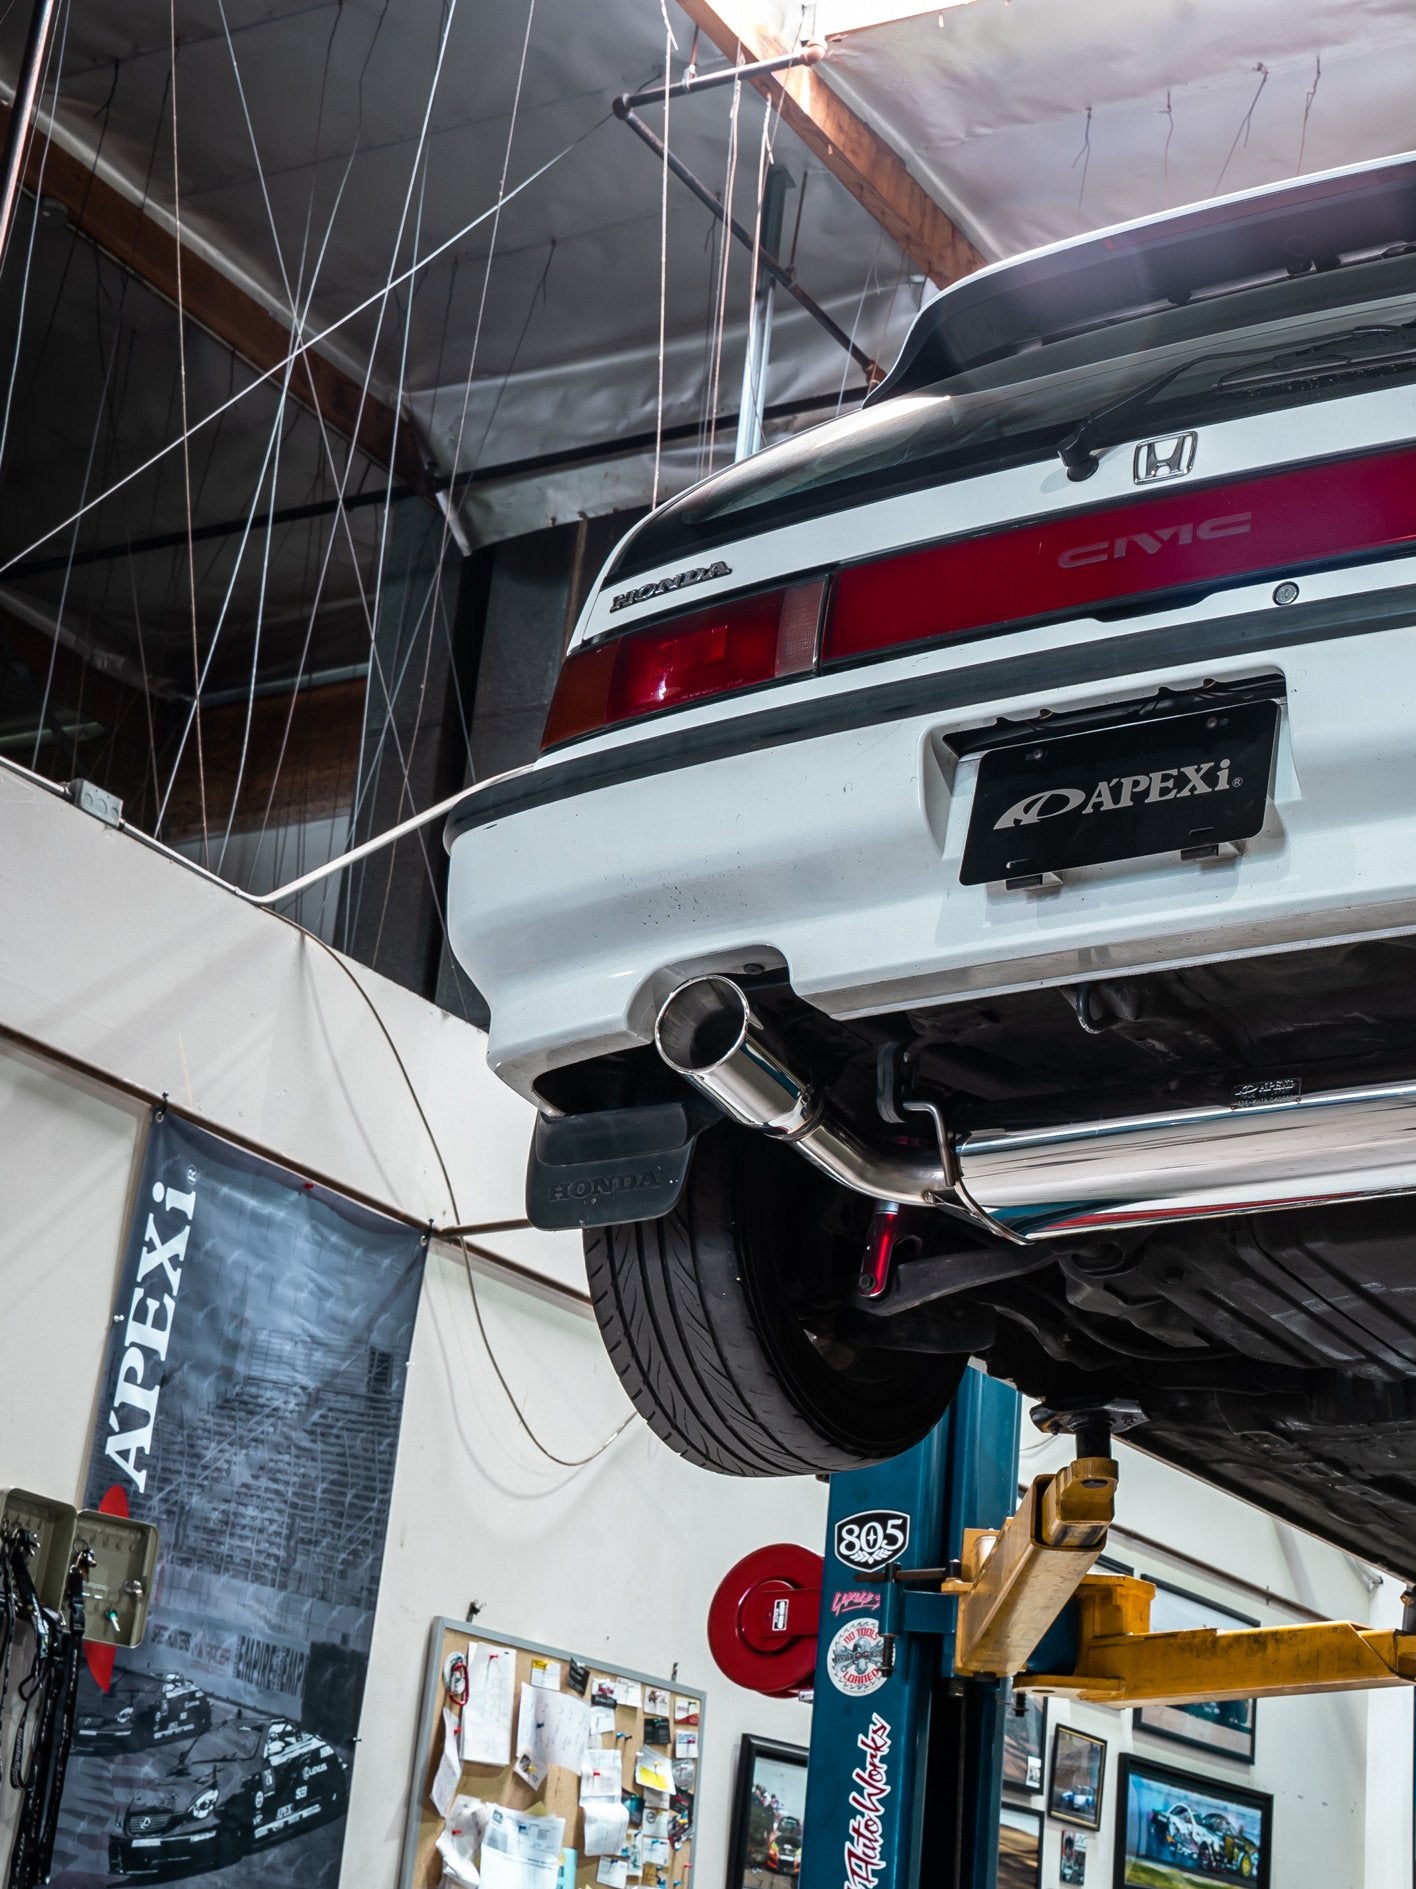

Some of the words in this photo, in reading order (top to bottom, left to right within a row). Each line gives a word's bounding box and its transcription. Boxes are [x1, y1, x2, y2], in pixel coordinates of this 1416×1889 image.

[1057, 512, 1252, 569] CIVIC
[609, 560, 733, 614] HONDA
[547, 1168, 662, 1203] HONDA
[839, 1518, 905, 1556] 805
[843, 1631, 855, 1645] NO
[856, 1627, 879, 1642] TOOLS
